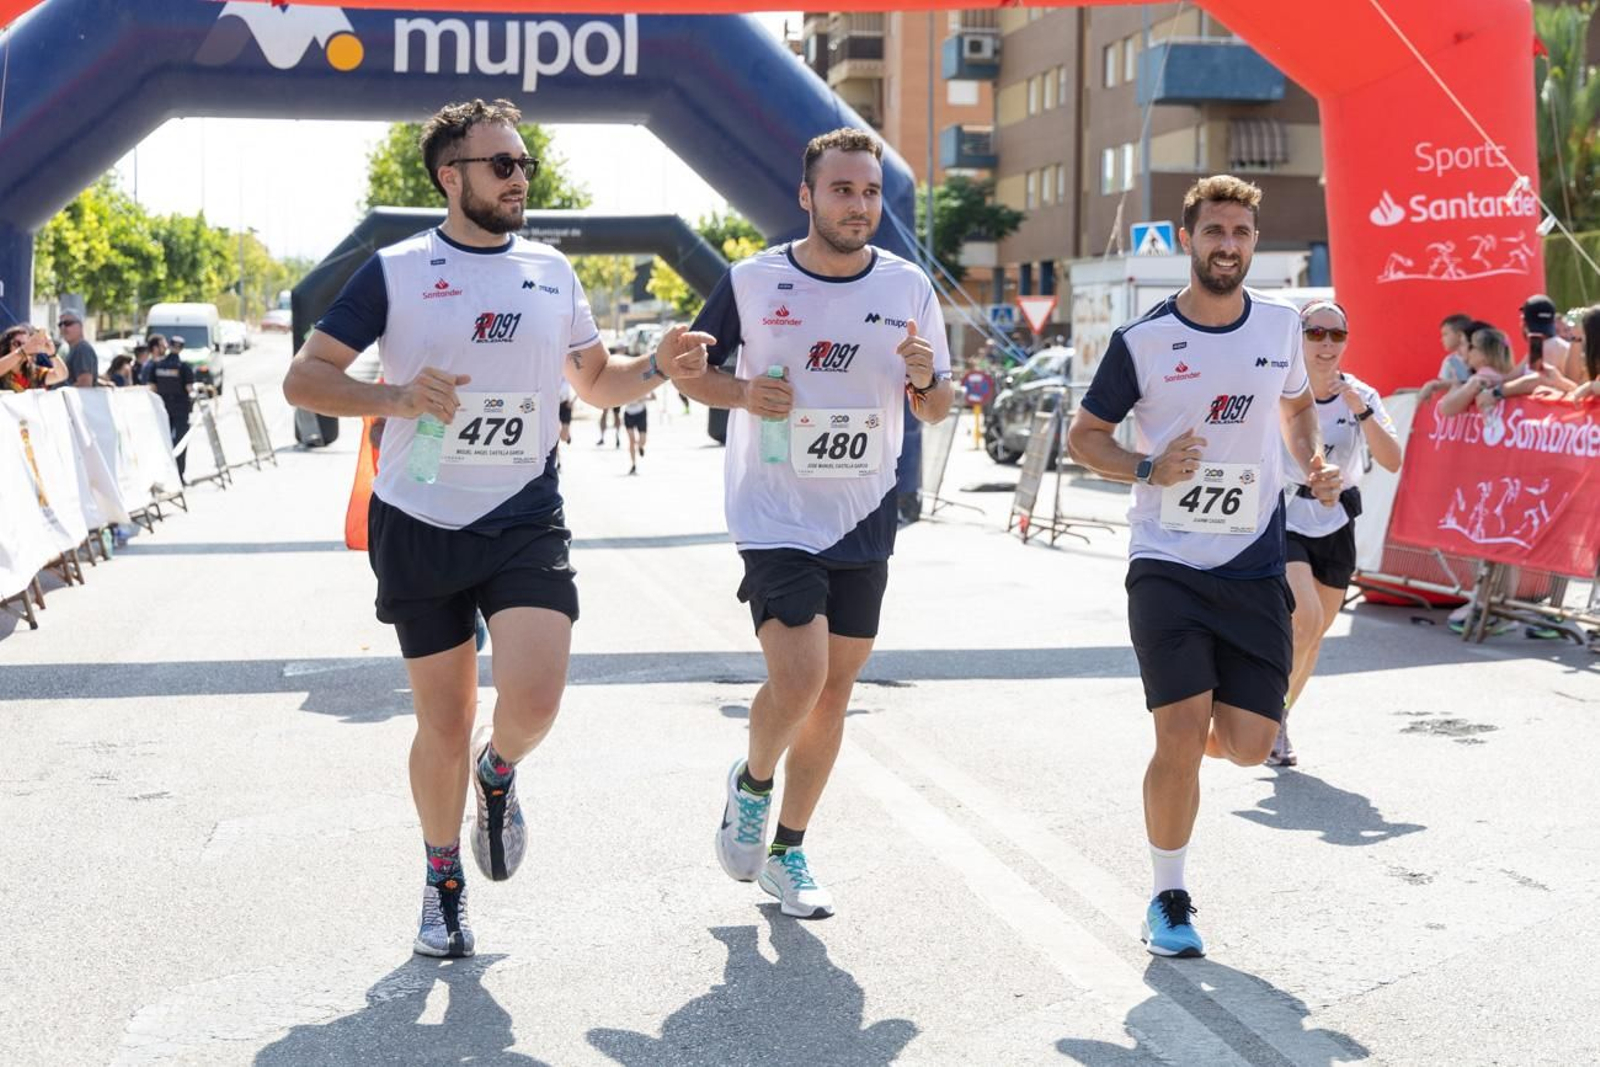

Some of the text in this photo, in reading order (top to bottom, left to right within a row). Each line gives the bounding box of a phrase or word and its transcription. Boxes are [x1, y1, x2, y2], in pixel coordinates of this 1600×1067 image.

[394, 13, 638, 92] mupol
[1415, 141, 1507, 177] Sports
[422, 289, 463, 300] Santander
[763, 318, 802, 327] Santander
[884, 316, 908, 329] mupo
[1164, 372, 1201, 383] Santander
[458, 417, 523, 446] 479
[1504, 409, 1600, 457] Santande
[807, 432, 868, 460] 480
[1179, 486, 1243, 515] 476
